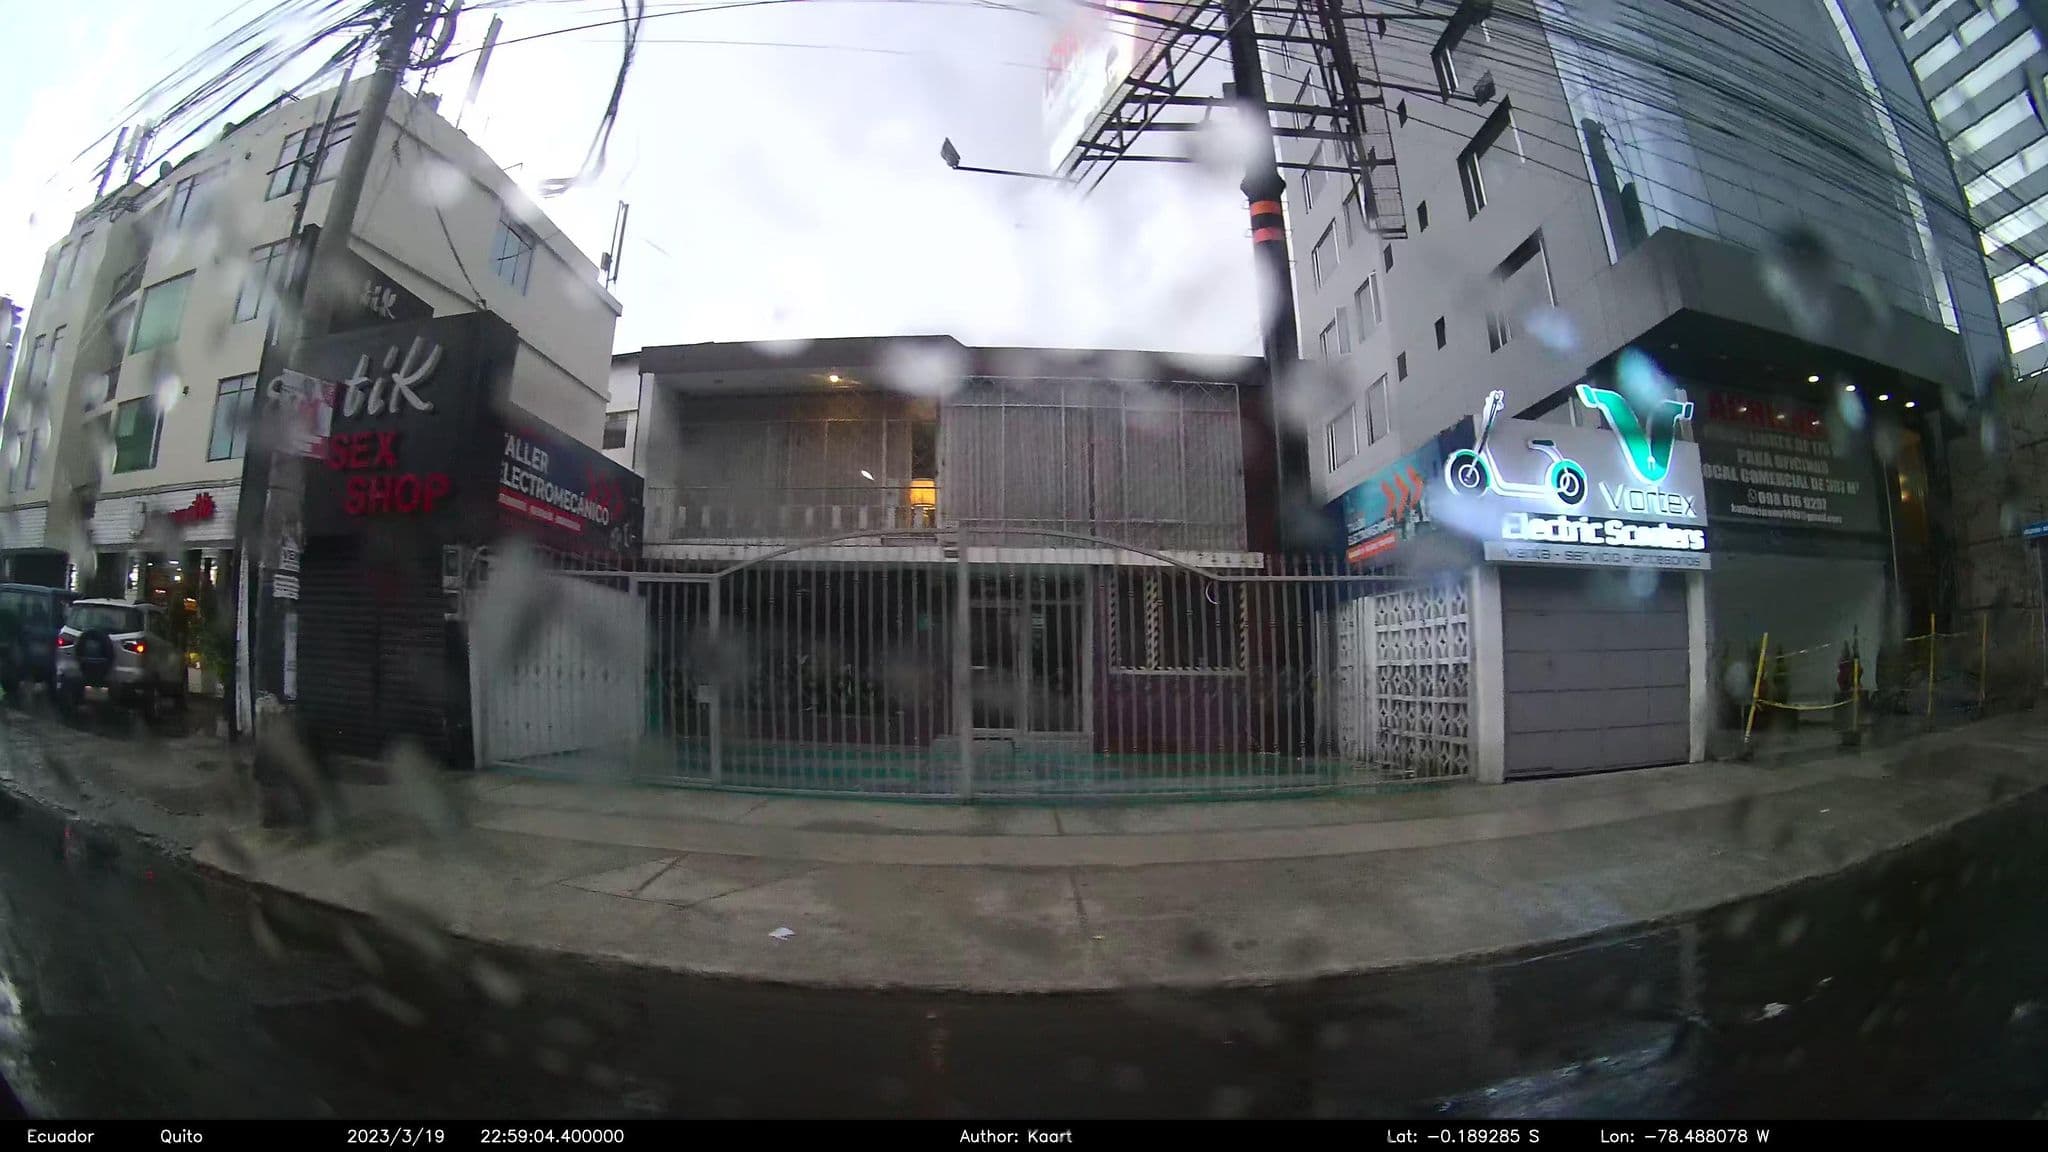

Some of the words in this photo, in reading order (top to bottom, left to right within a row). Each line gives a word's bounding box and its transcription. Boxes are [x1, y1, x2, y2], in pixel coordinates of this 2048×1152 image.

[327, 431, 397, 470] SEX
[504, 433, 549, 474] ALLER
[1702, 463, 1739, 482] OCAL
[345, 472, 451, 514] SHOP
[500, 462, 609, 526] LECTROMECÁNICO
[1599, 481, 1697, 518] Vortex
[1501, 512, 1604, 543] Electric
[1604, 519, 1706, 550] Scooters
